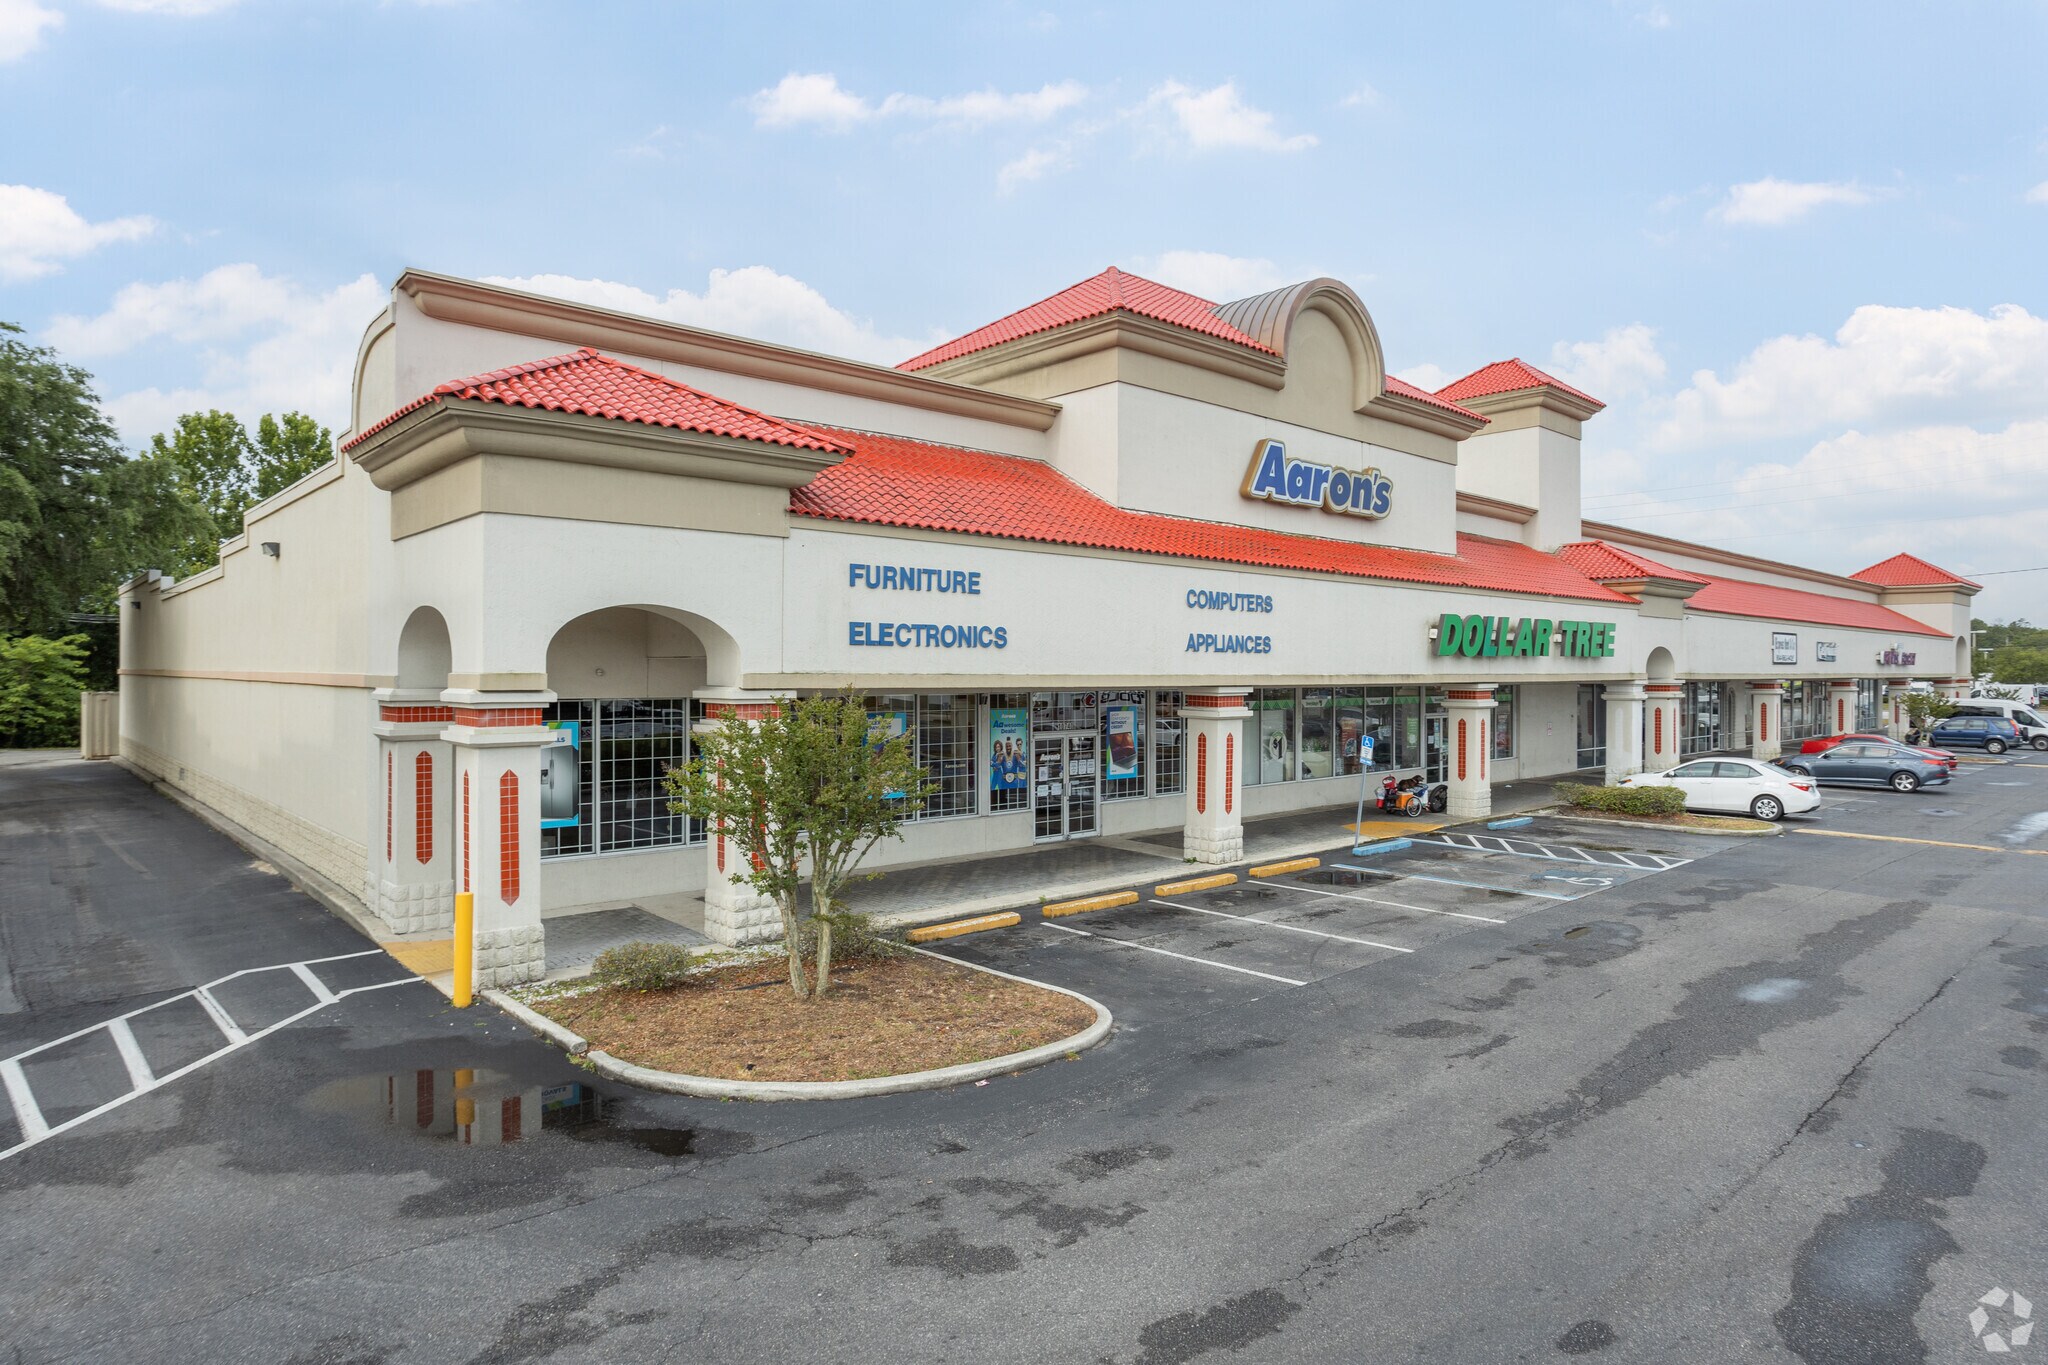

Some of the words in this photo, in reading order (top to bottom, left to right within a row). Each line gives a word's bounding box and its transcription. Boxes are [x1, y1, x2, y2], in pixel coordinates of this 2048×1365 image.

[1252, 441, 1392, 517] Aaron's
[849, 563, 981, 594] FURNITURE
[1186, 589, 1273, 613] COMPUTERS
[849, 621, 1008, 649] ELECTRONICS
[1185, 633, 1272, 653] APPLIANCES
[1436, 613, 1553, 657] DOLLAR
[1560, 620, 1617, 657] TREE
